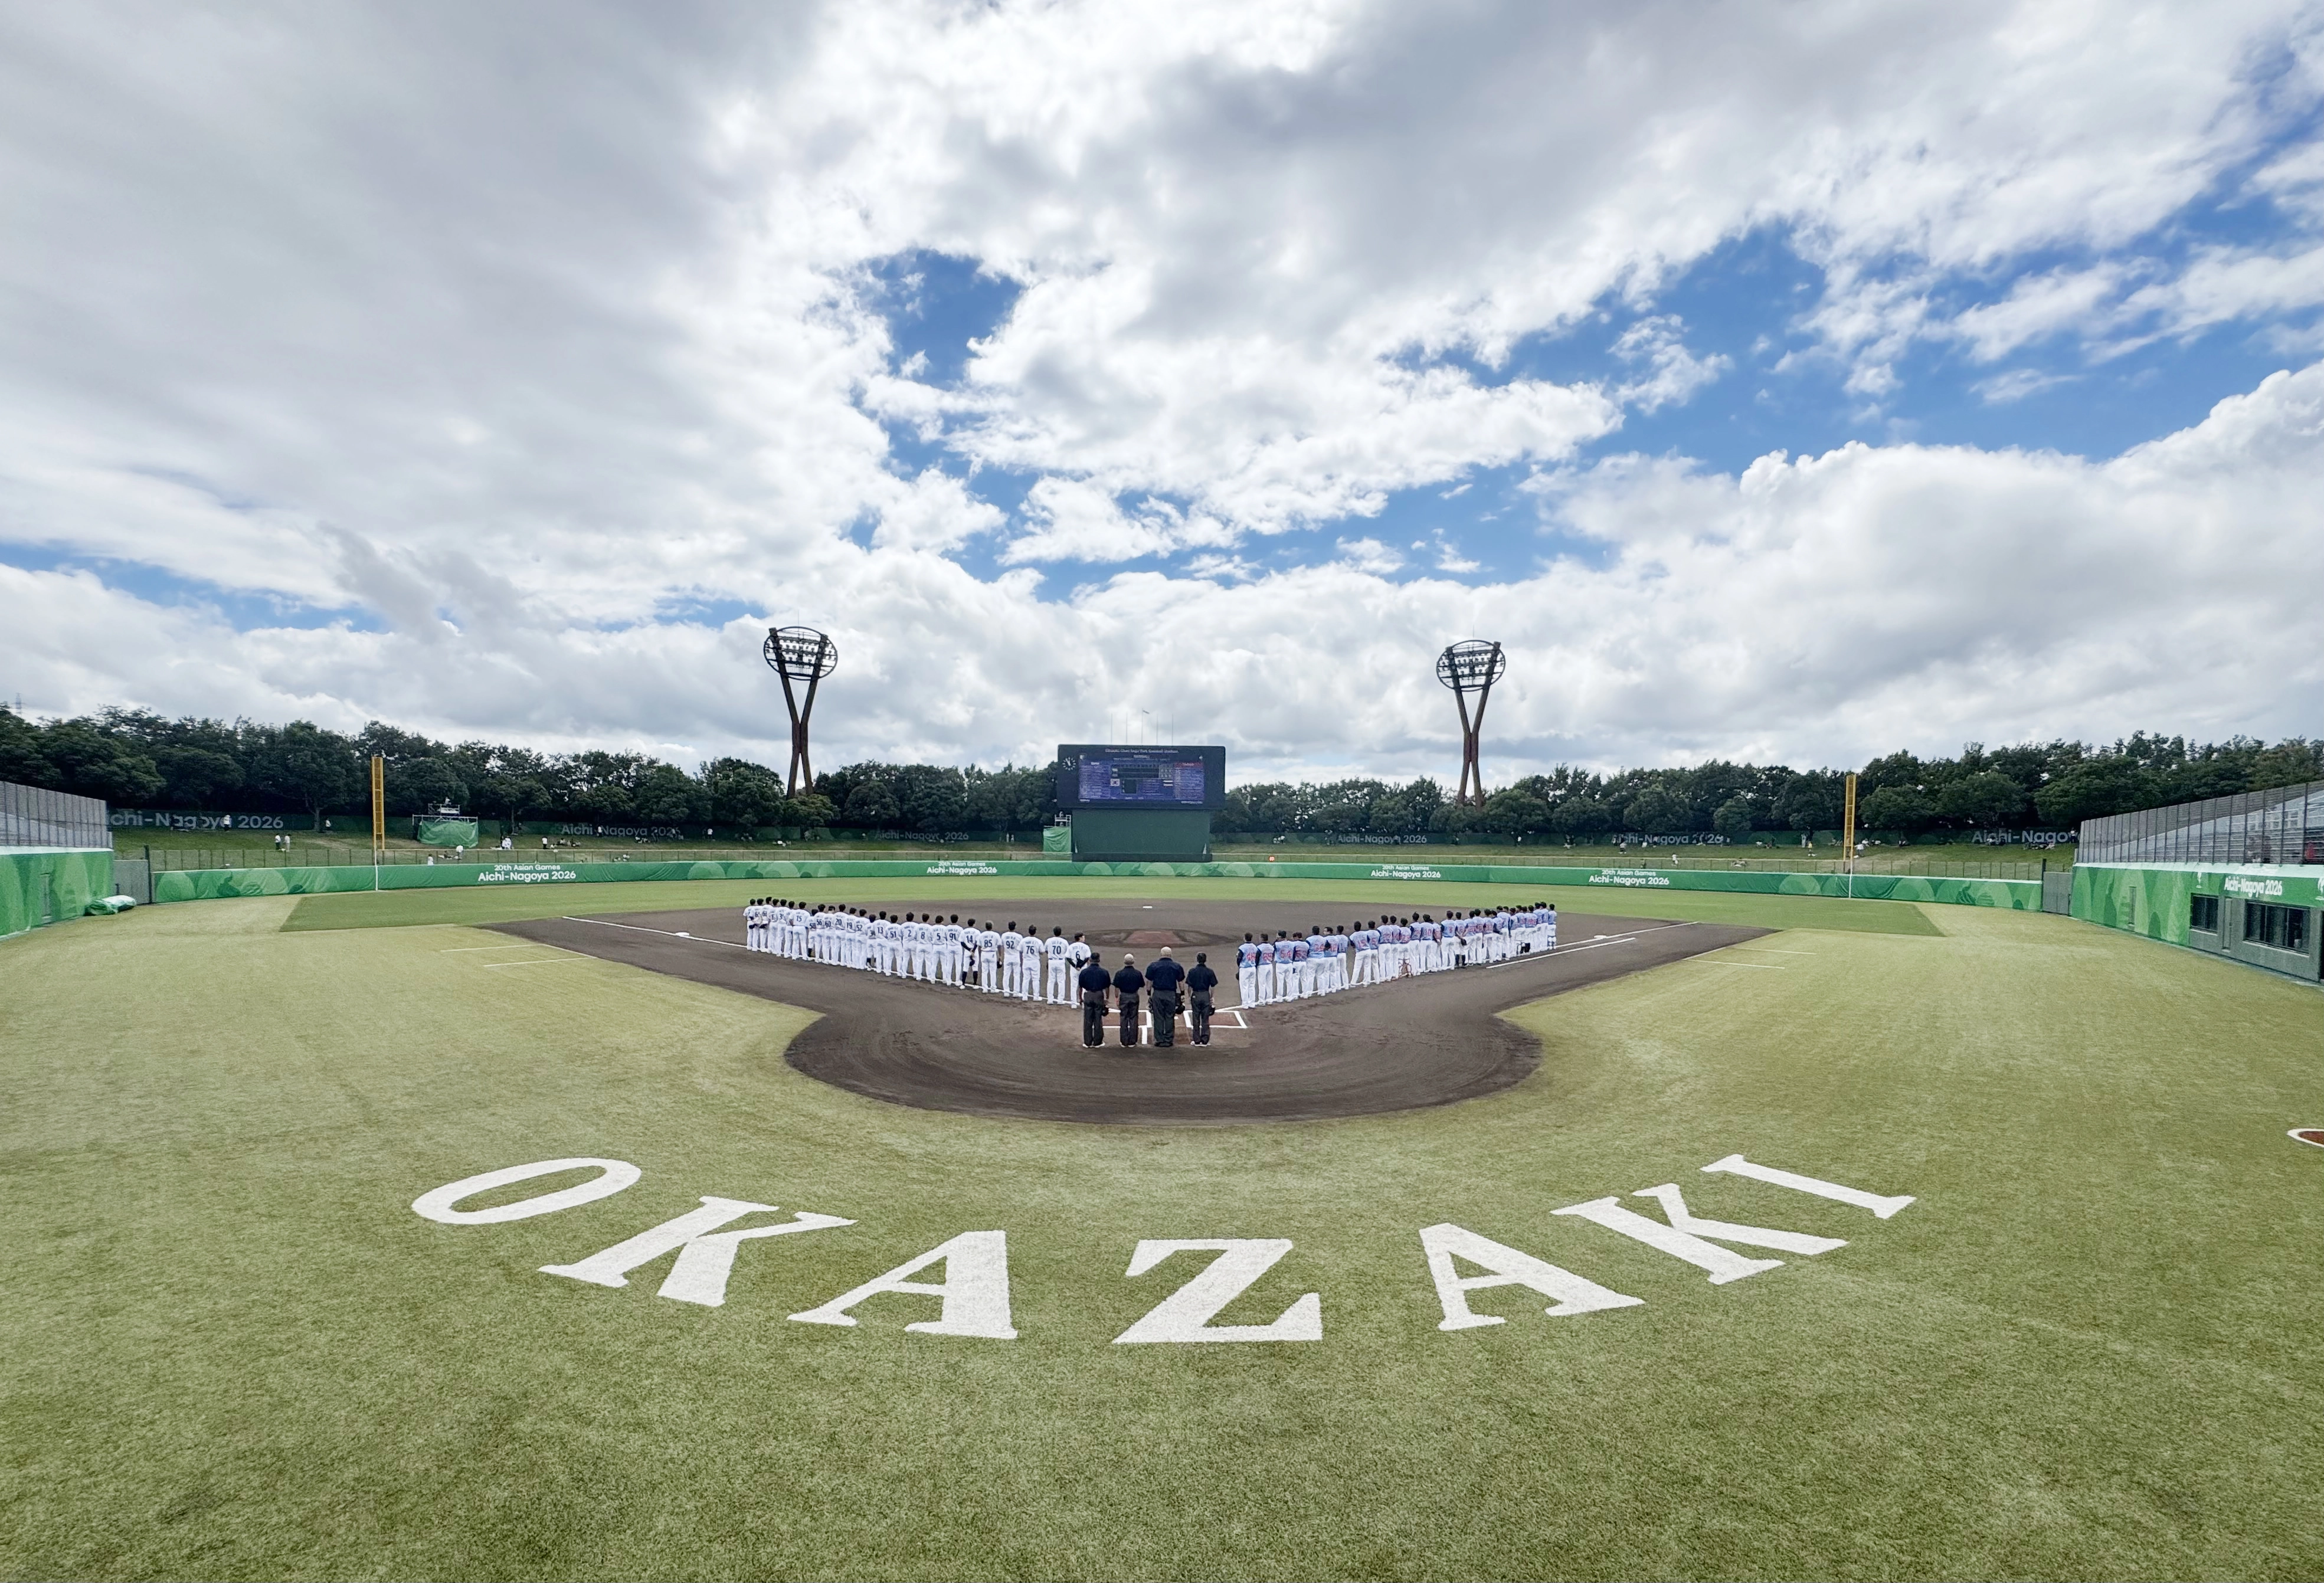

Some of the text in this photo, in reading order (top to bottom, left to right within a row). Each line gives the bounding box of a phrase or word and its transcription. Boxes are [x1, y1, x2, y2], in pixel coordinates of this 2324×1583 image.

[238, 815, 284, 829] 2026
[561, 823, 647, 837] AichiNagoya
[945, 832, 969, 840] 2026
[1403, 835, 1427, 843] 2026
[1612, 833, 1723, 845] ichi-Ngoya 226
[927, 866, 977, 875] Aichi-Nagoya
[1371, 870, 1421, 879] Aichi-Nagoya
[478, 871, 577, 883] Aichi-Nagoya 2026
[1589, 874, 1670, 886] Aichi-Nagoya 2026
[2224, 876, 2283, 897] Aichi-Nagoya 2026
[908, 929, 912, 938] 2
[965, 935, 973, 944] 14
[984, 939, 993, 948] 85
[1006, 940, 1014, 949] 92
[1026, 945, 1035, 955] 76
[1052, 945, 1062, 955] 70
[412, 1154, 1915, 1343] OKAZAKI
